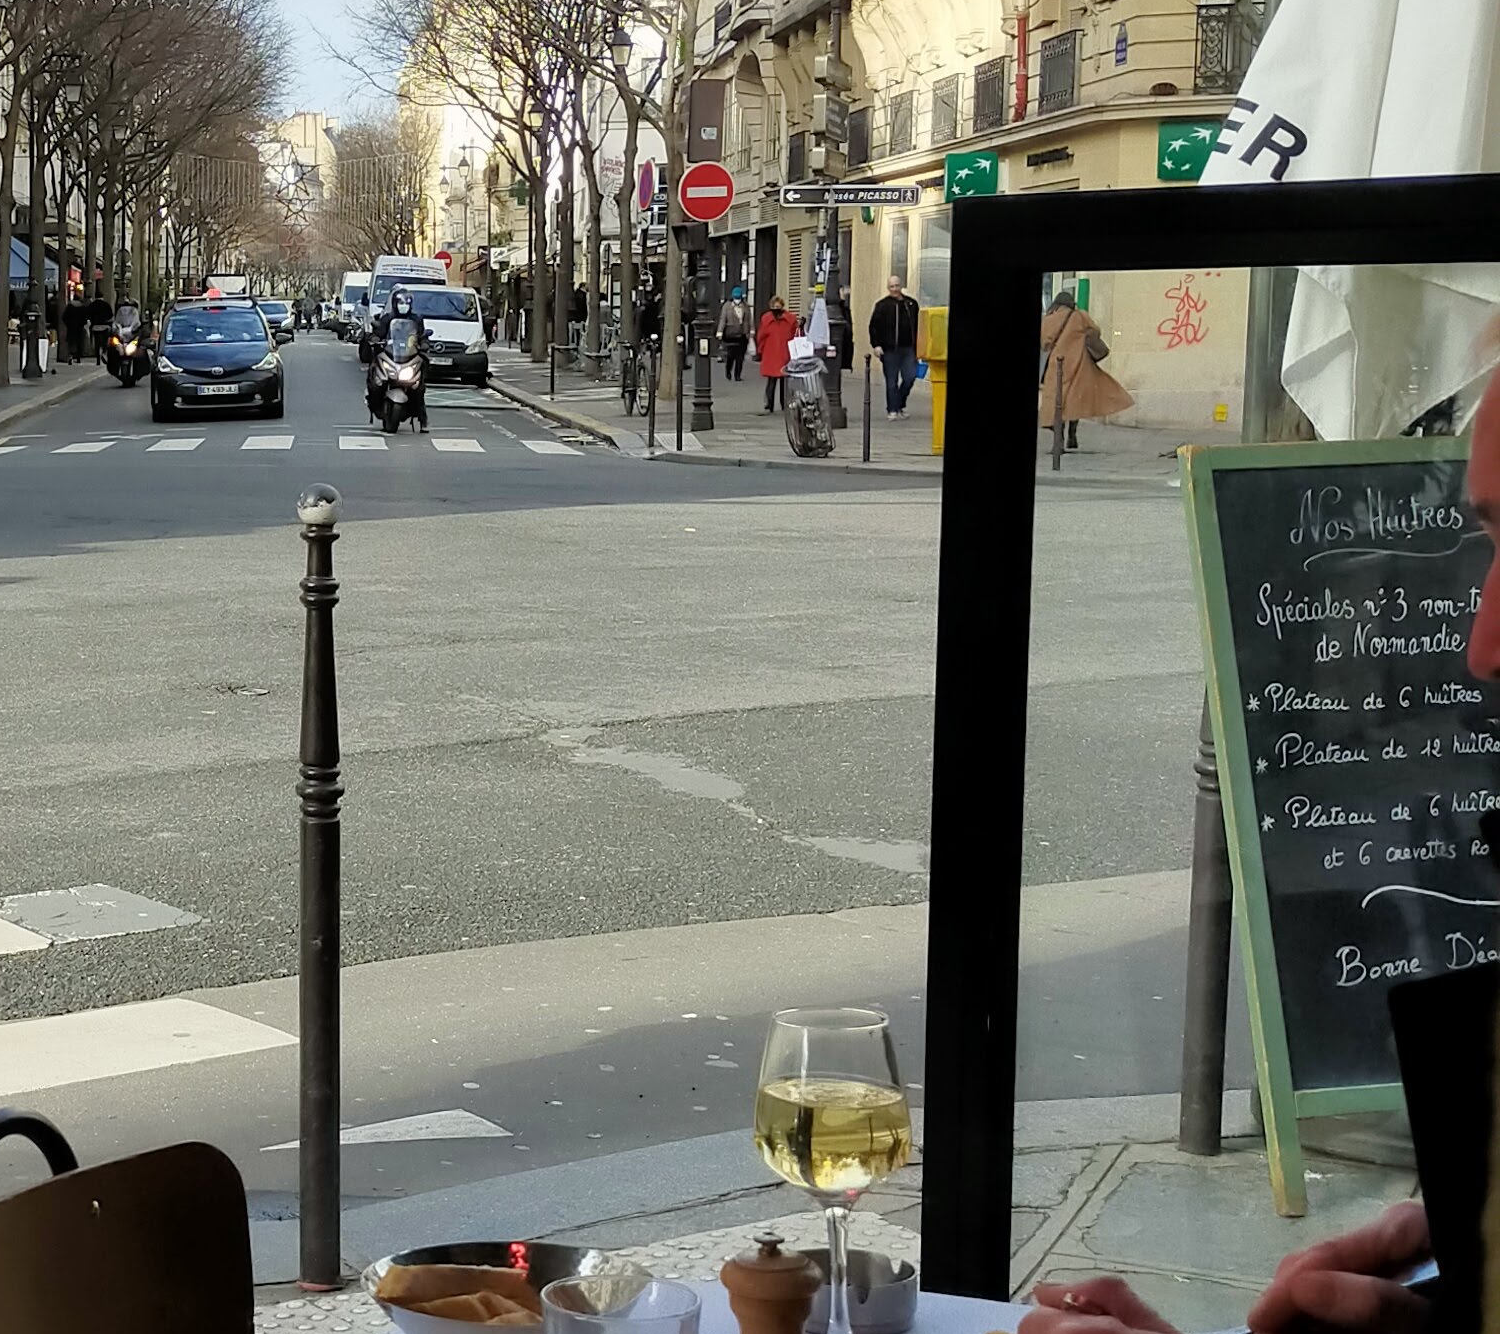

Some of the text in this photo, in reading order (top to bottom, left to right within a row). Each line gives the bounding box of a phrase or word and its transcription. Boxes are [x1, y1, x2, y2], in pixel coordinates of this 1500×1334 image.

[857, 191, 900, 201] PICASSO
[1290, 485, 1355, 545] Nos
[1256, 582, 1356, 642] Spéciales
[1391, 587, 1408, 623] 3
[1315, 621, 1467, 664] de Normandie
[1264, 682, 1350, 713] Plateau
[1362, 692, 1386, 711] de
[1399, 685, 1413, 708] 6
[1274, 732, 1370, 769] Plateau
[1381, 738, 1408, 759] de
[1420, 739, 1443, 758] 12
[1284, 795, 1377, 829] Plateau
[1390, 802, 1413, 821] de
[1428, 793, 1442, 817] 6
[1323, 847, 1345, 870] et
[1358, 840, 1374, 866] 6
[1335, 945, 1423, 987] Bonne
